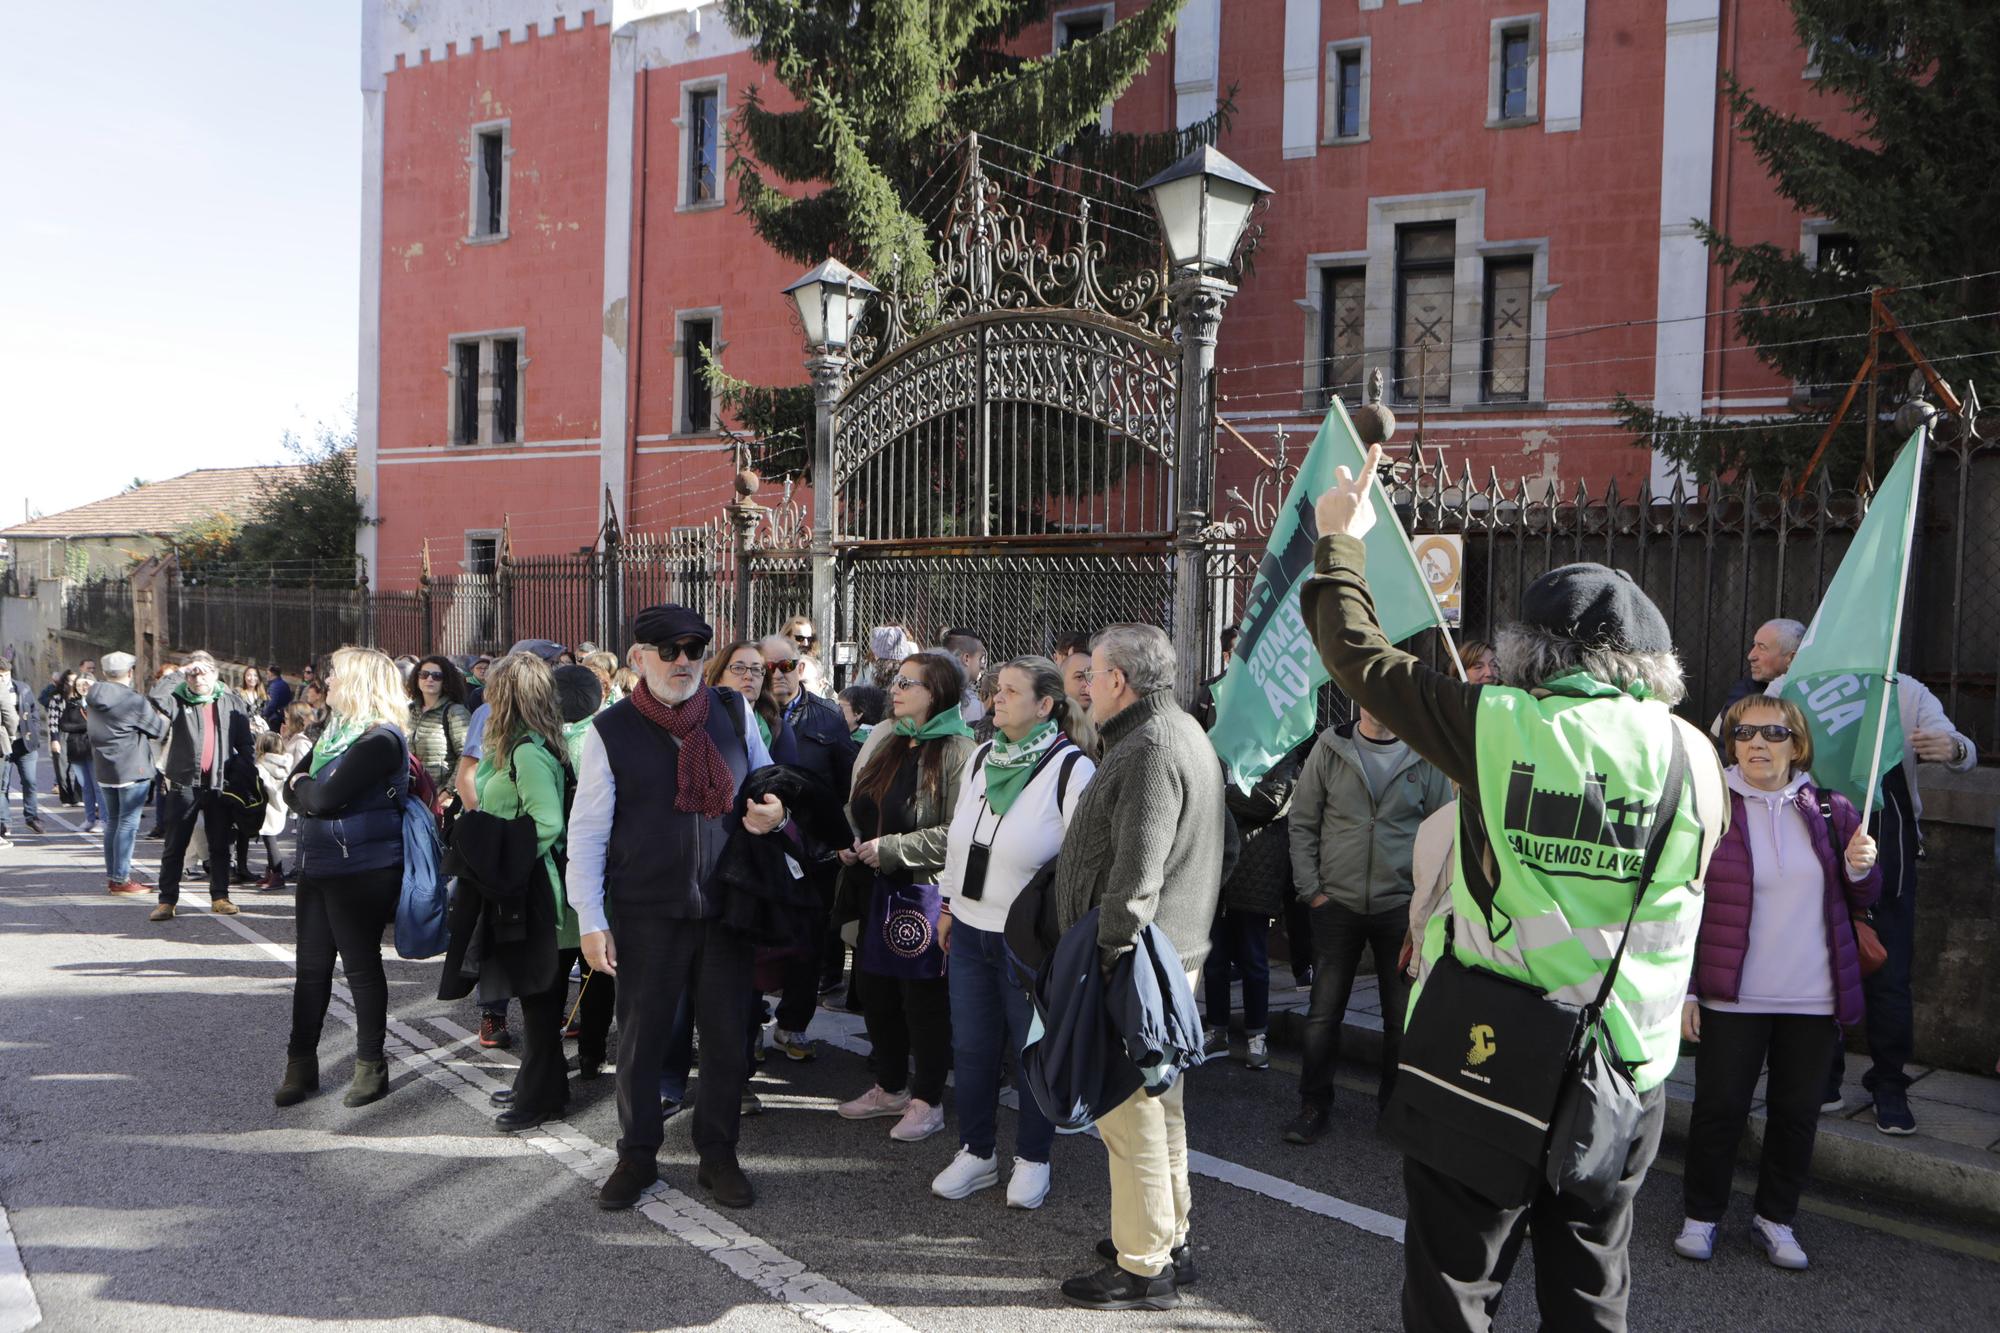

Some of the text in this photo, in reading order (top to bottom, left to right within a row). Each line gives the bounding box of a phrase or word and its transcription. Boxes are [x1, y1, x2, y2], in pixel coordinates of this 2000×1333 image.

[1508, 835, 1644, 873] SALVEMOS LA VE
